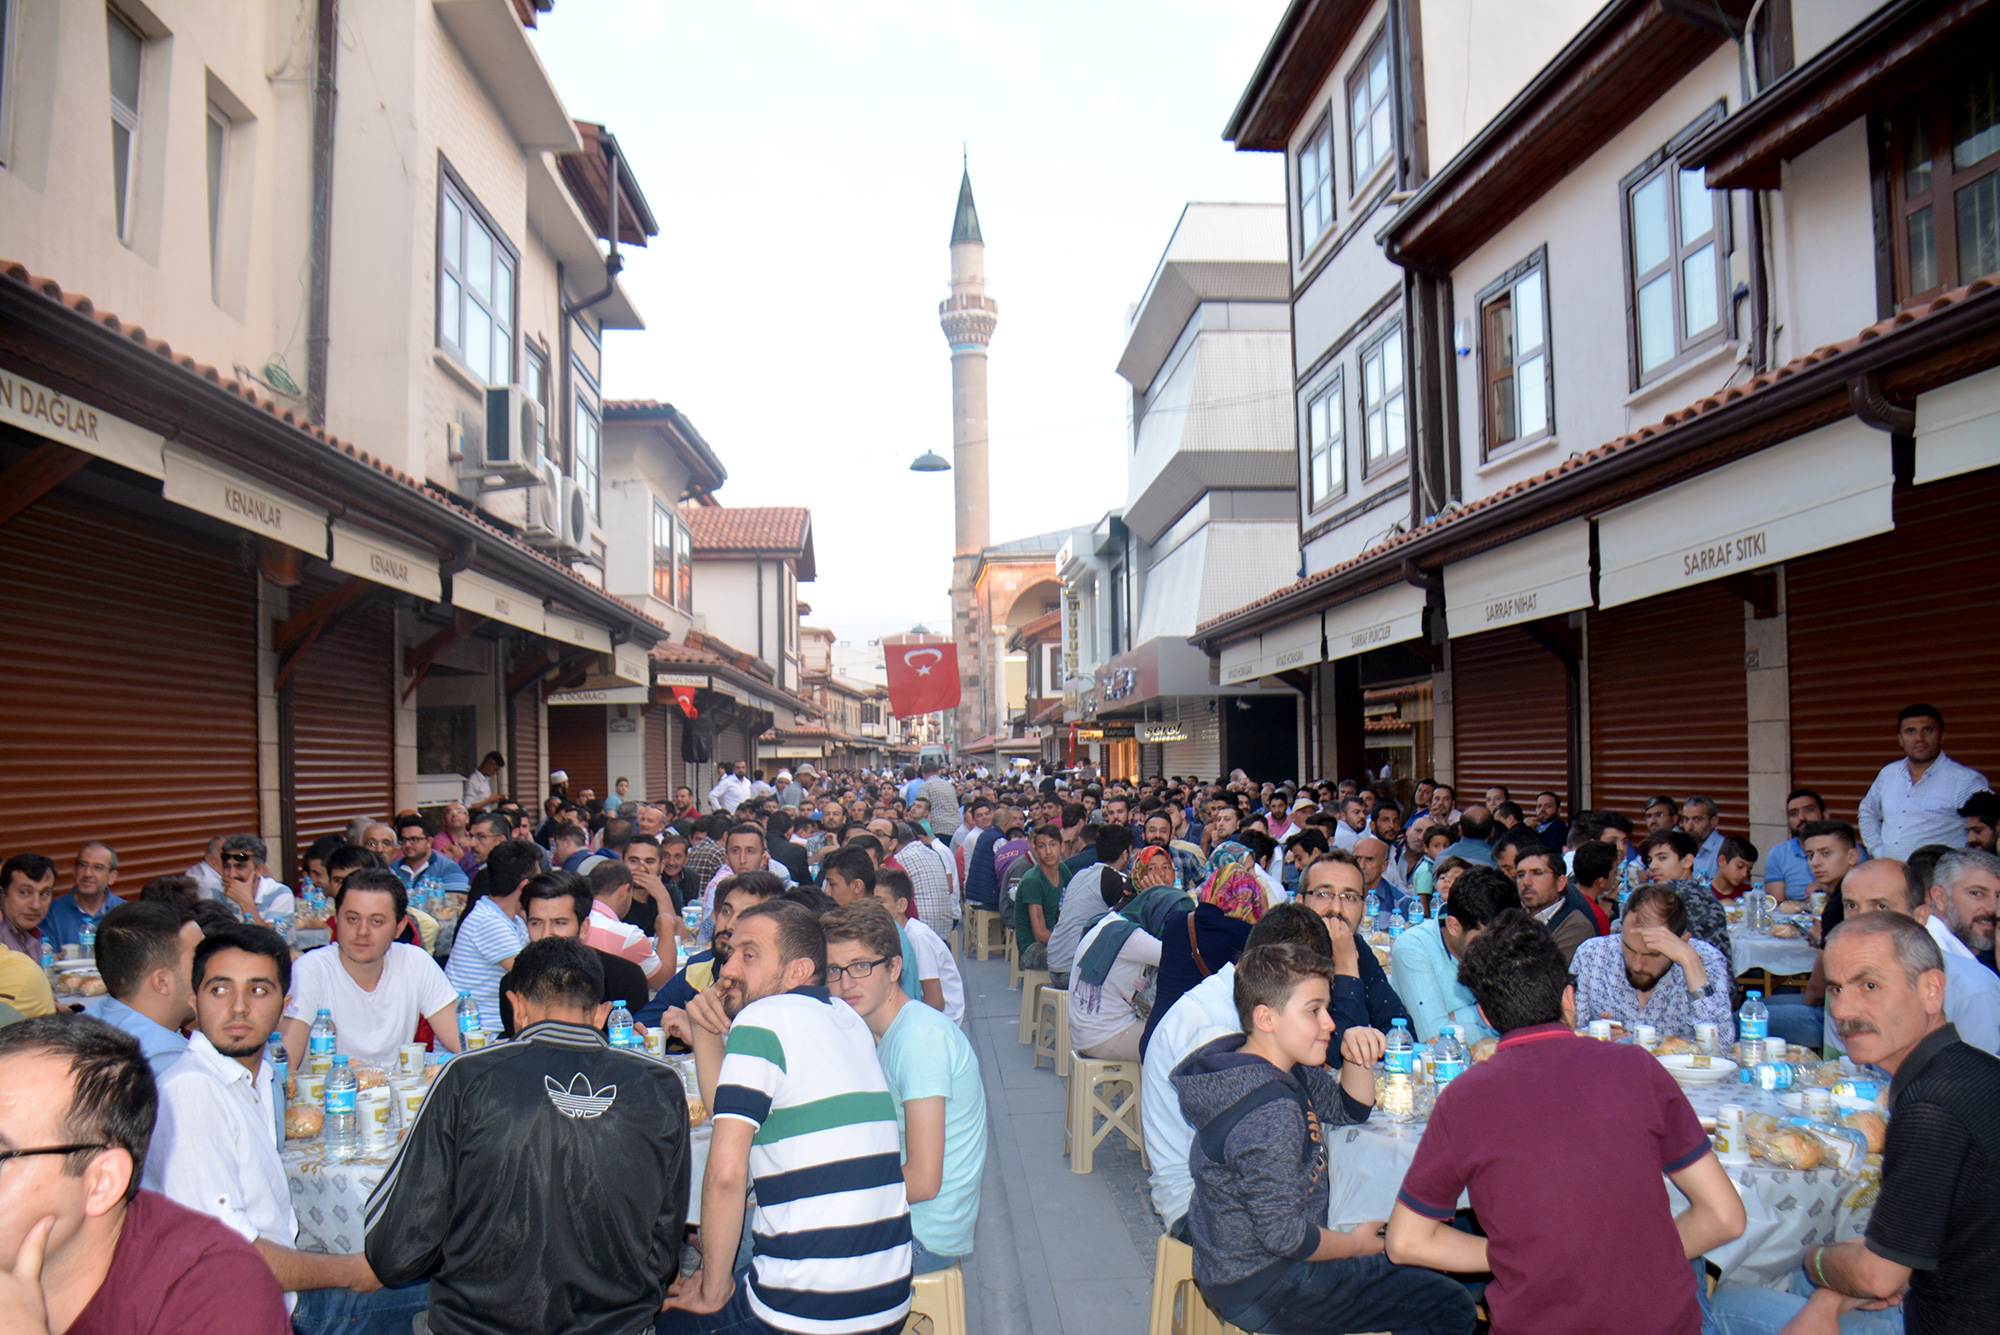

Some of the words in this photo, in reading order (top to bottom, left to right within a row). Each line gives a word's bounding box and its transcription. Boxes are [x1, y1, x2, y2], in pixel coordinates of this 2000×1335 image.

[224, 486, 281, 530] KENANLAR
[370, 552, 409, 583] KENANLAR
[1684, 541, 1732, 576] SARRAF
[1736, 531, 1766, 561] SITKI
[1485, 599, 1513, 622] SARRAF
